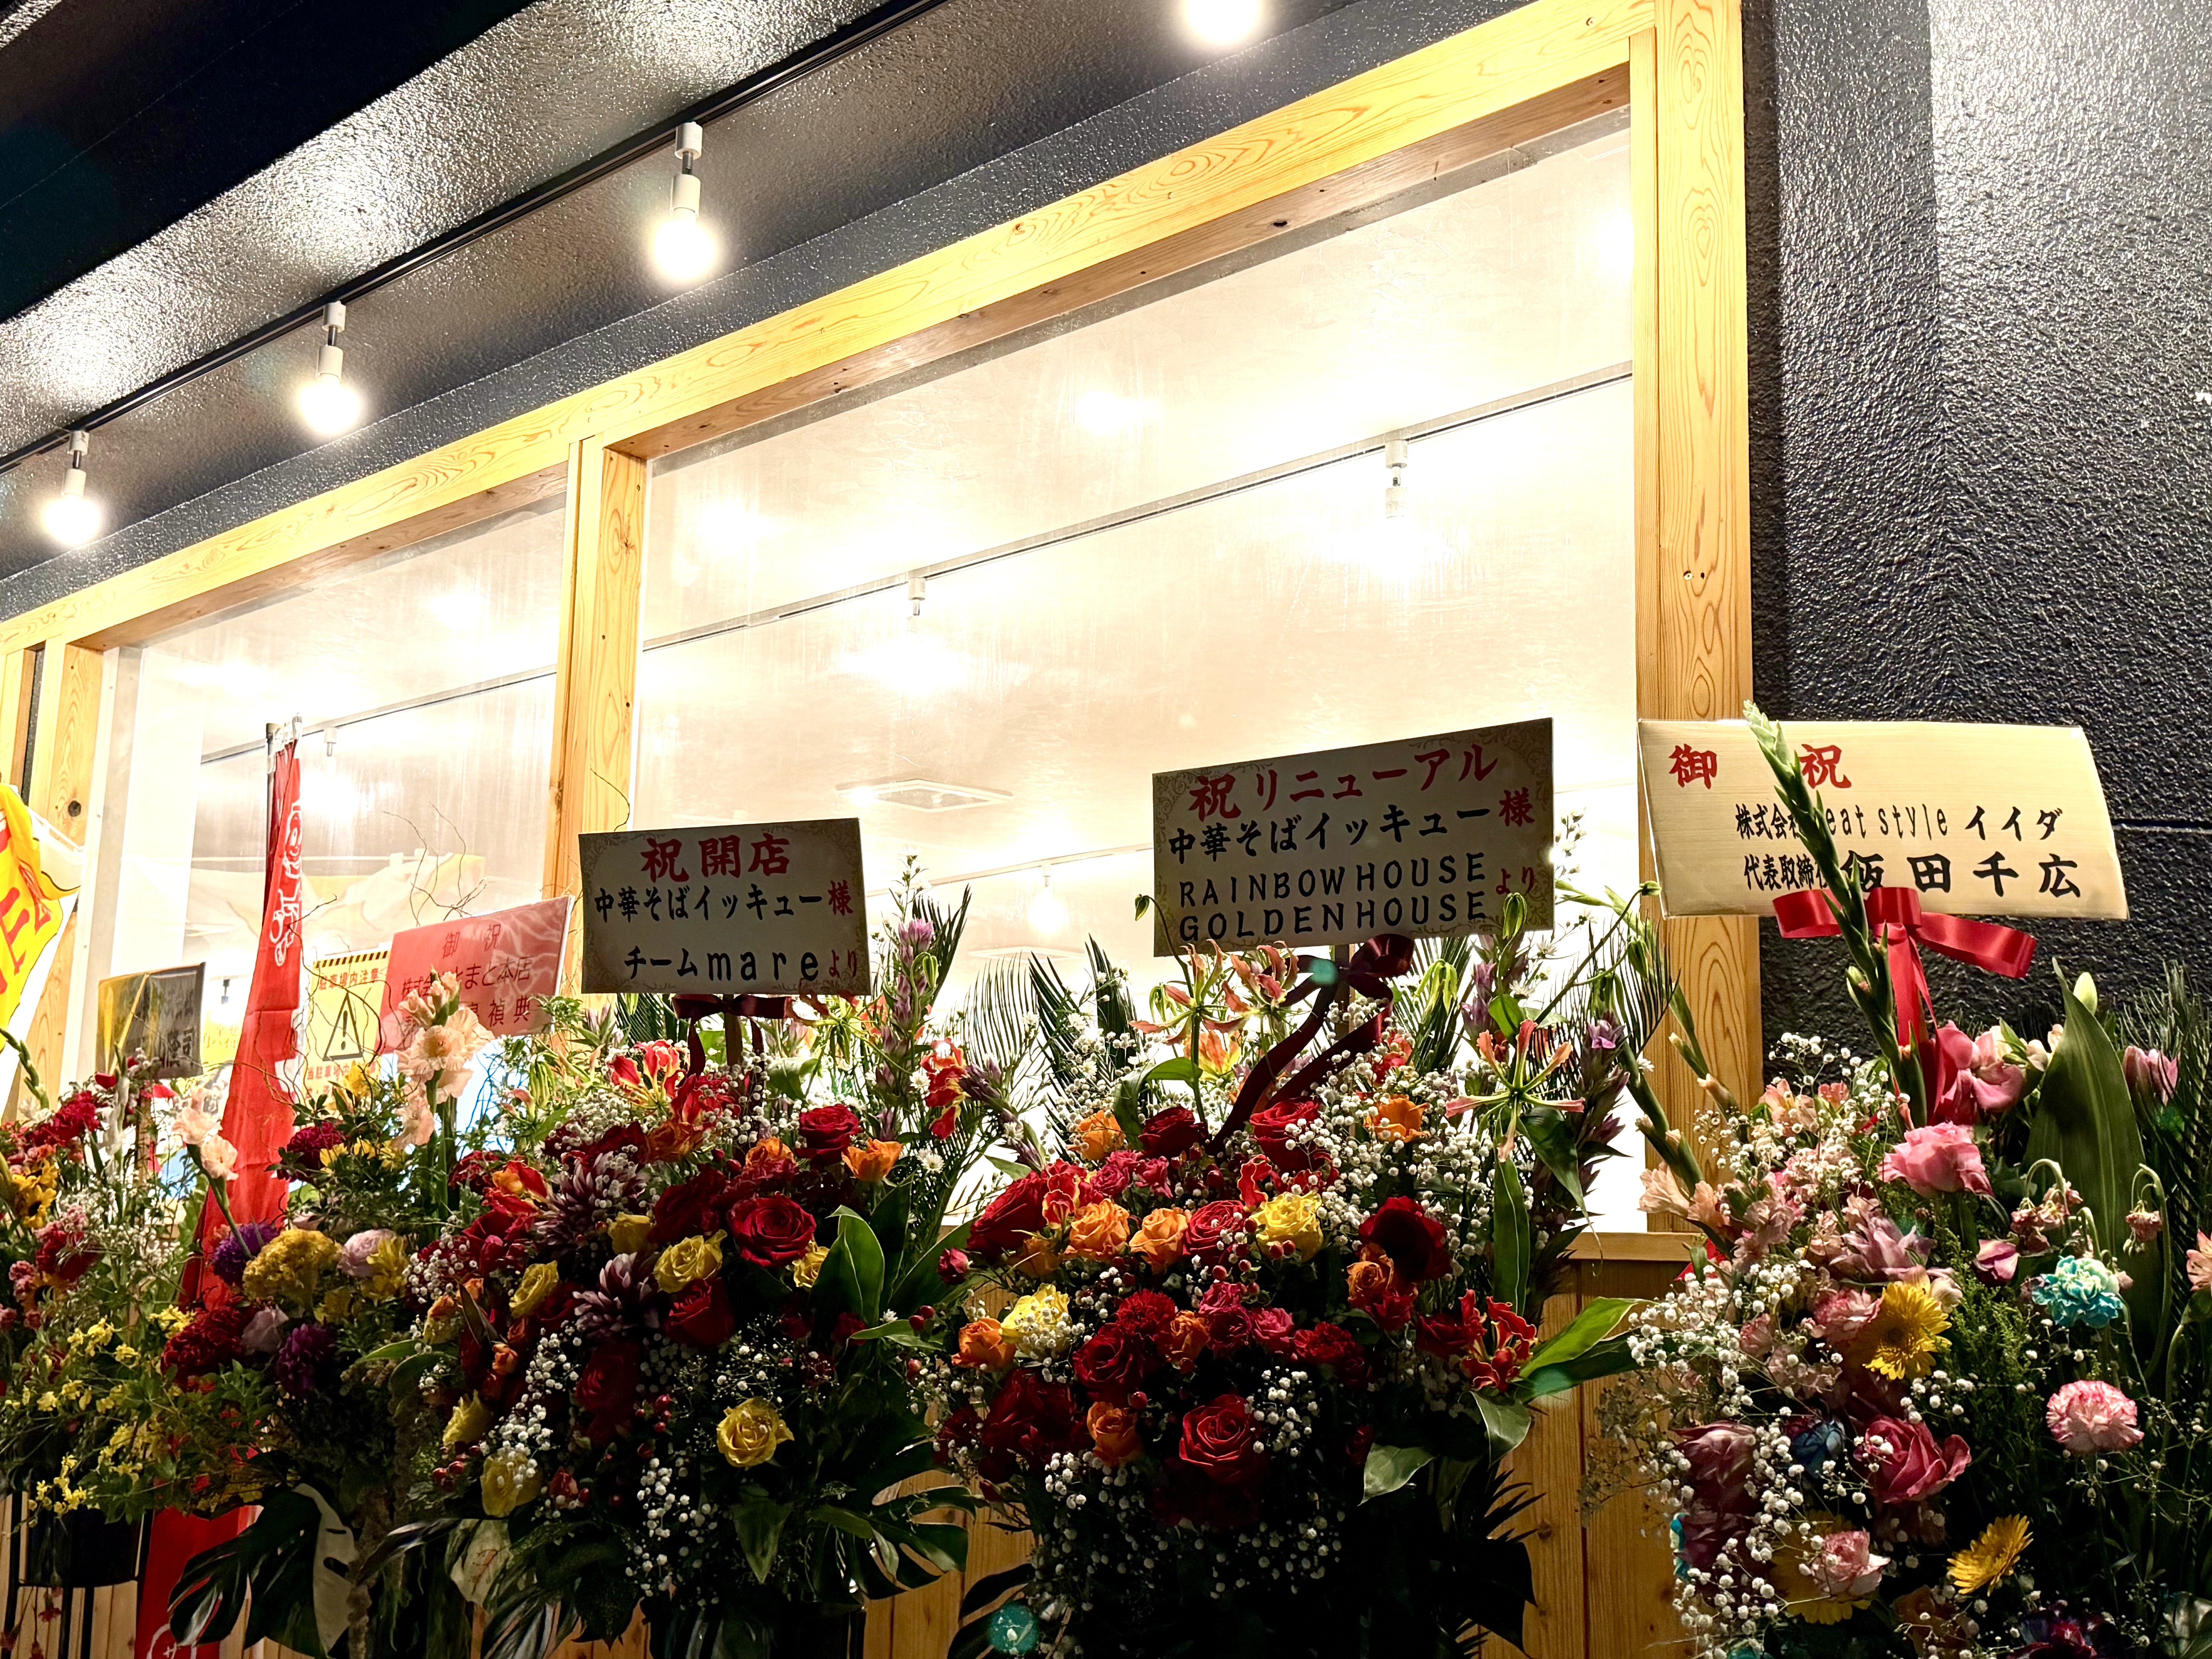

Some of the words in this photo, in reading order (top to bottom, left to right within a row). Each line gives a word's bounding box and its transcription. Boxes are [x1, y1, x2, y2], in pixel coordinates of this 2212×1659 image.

[1188, 744, 1498, 822] 祝リニューアル
[641, 832, 791, 883] 祝開店
[1496, 866, 1535, 896] より
